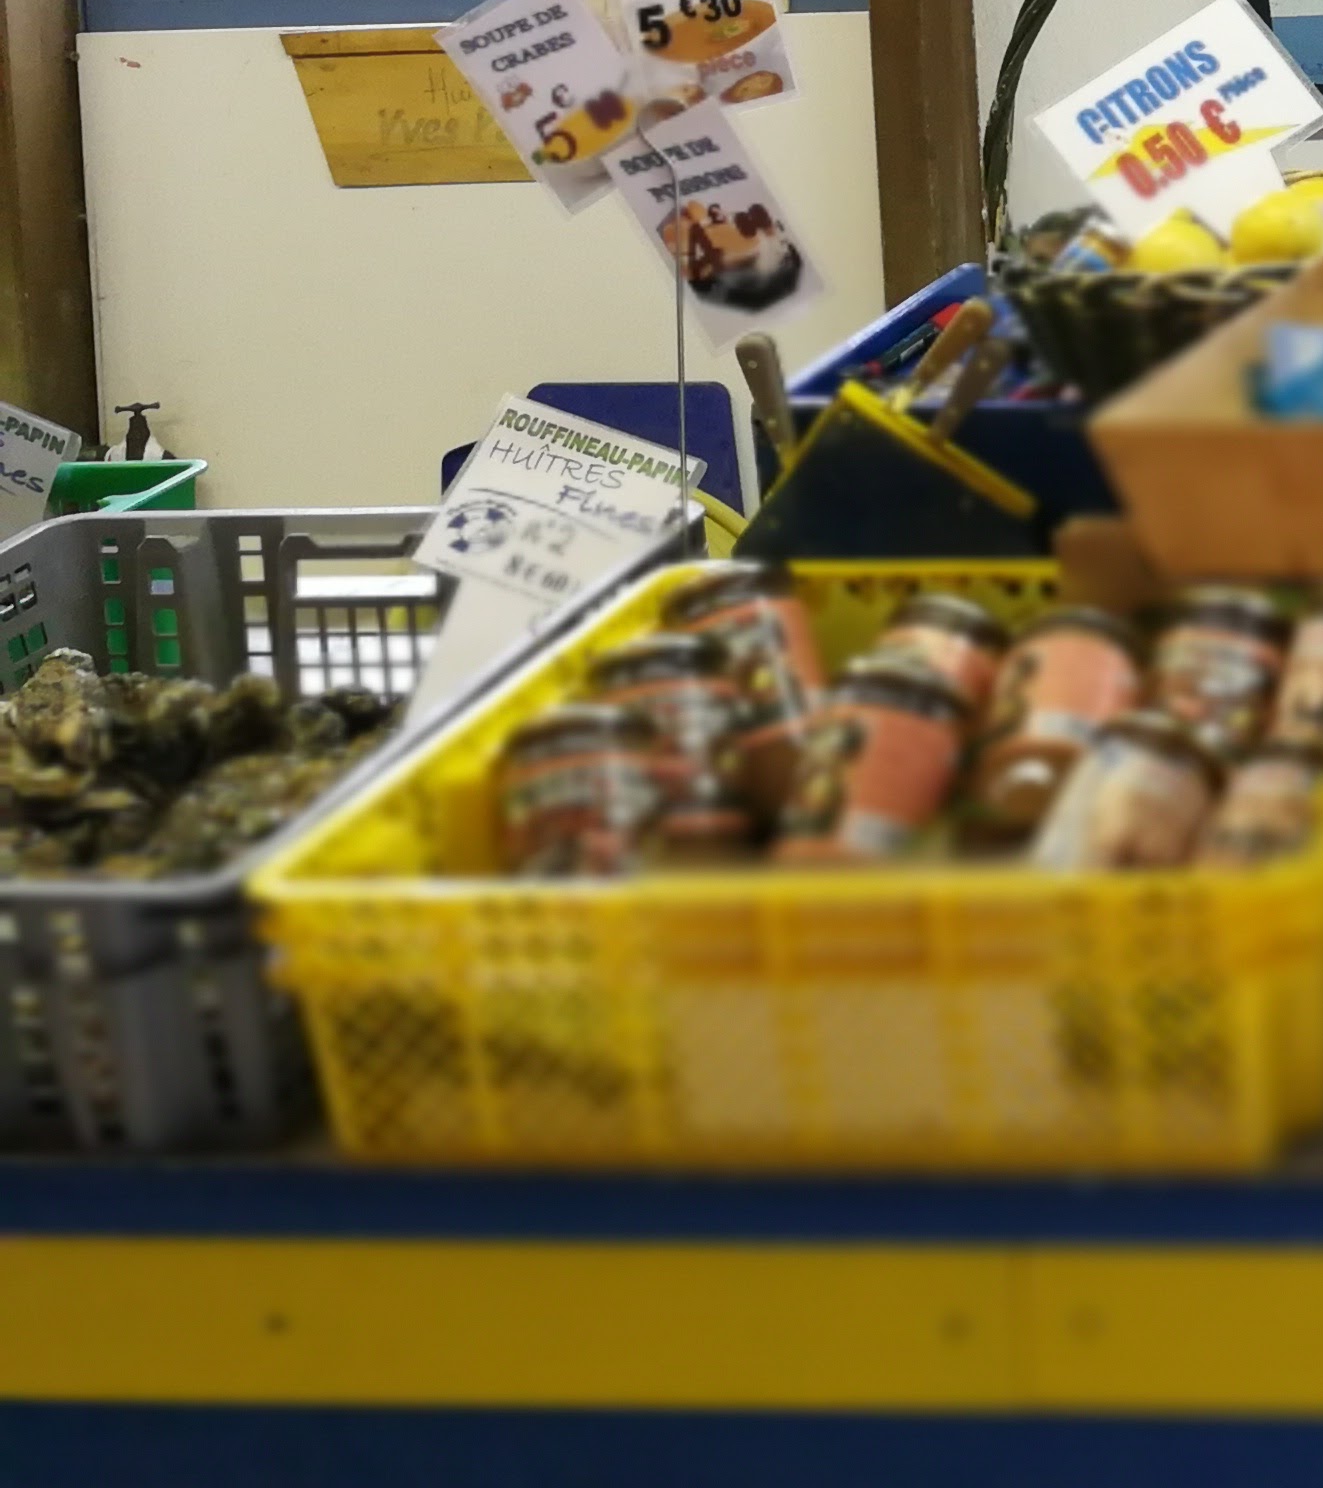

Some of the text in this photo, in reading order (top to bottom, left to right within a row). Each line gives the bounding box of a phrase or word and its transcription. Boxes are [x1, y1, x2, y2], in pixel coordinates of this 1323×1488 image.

[458, 4, 569, 55] SOUPE DE
[637, 3, 672, 50] 5
[491, 31, 577, 73] CRABES
[1075, 39, 1221, 146] CITRONS
[1199, 98, 1242, 146] €
[489, 439, 627, 489] HUÎTRES
